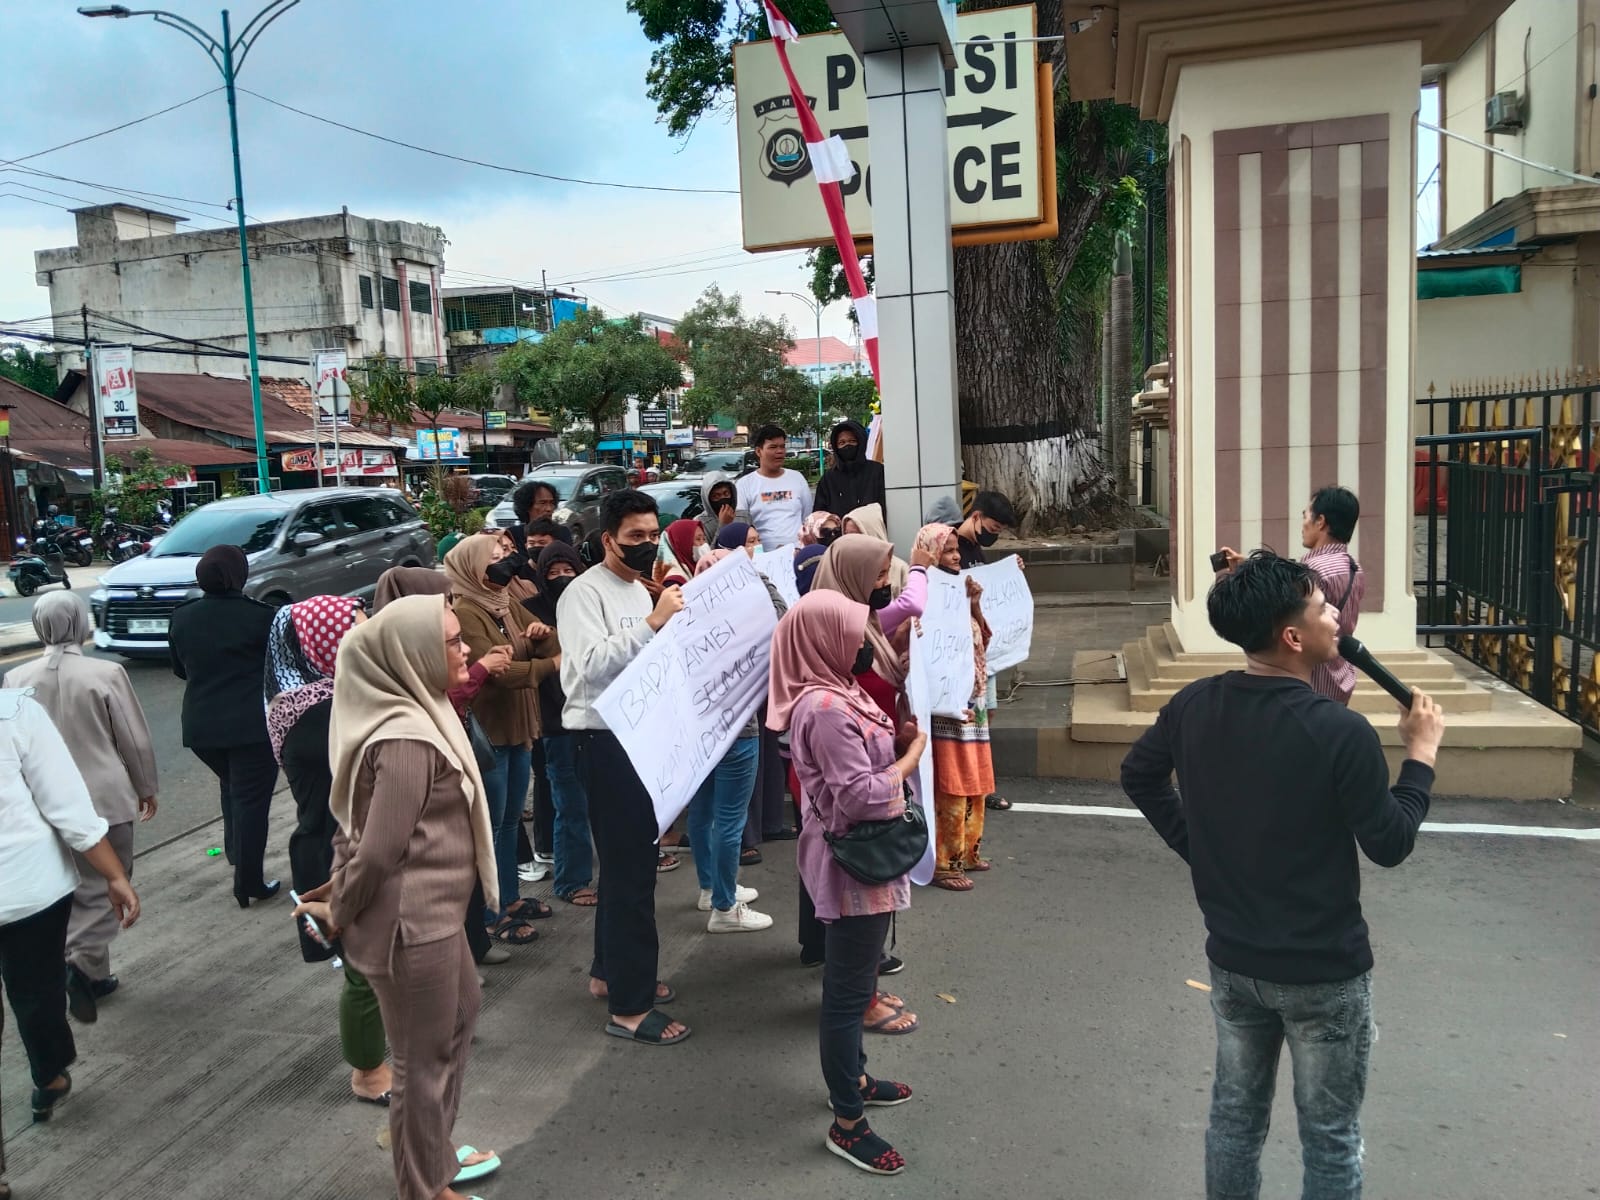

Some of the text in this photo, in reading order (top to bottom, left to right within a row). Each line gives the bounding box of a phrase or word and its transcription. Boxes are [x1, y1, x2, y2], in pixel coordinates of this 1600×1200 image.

[759, 98, 813, 113] JAMI
[827, 32, 1017, 111] PSI
[840, 141, 1022, 210] PCE
[691, 562, 758, 615] TAHUN
[678, 619, 736, 688] JAMBI
[692, 644, 767, 717] SEUMUR
[688, 707, 736, 778] HIDUP
